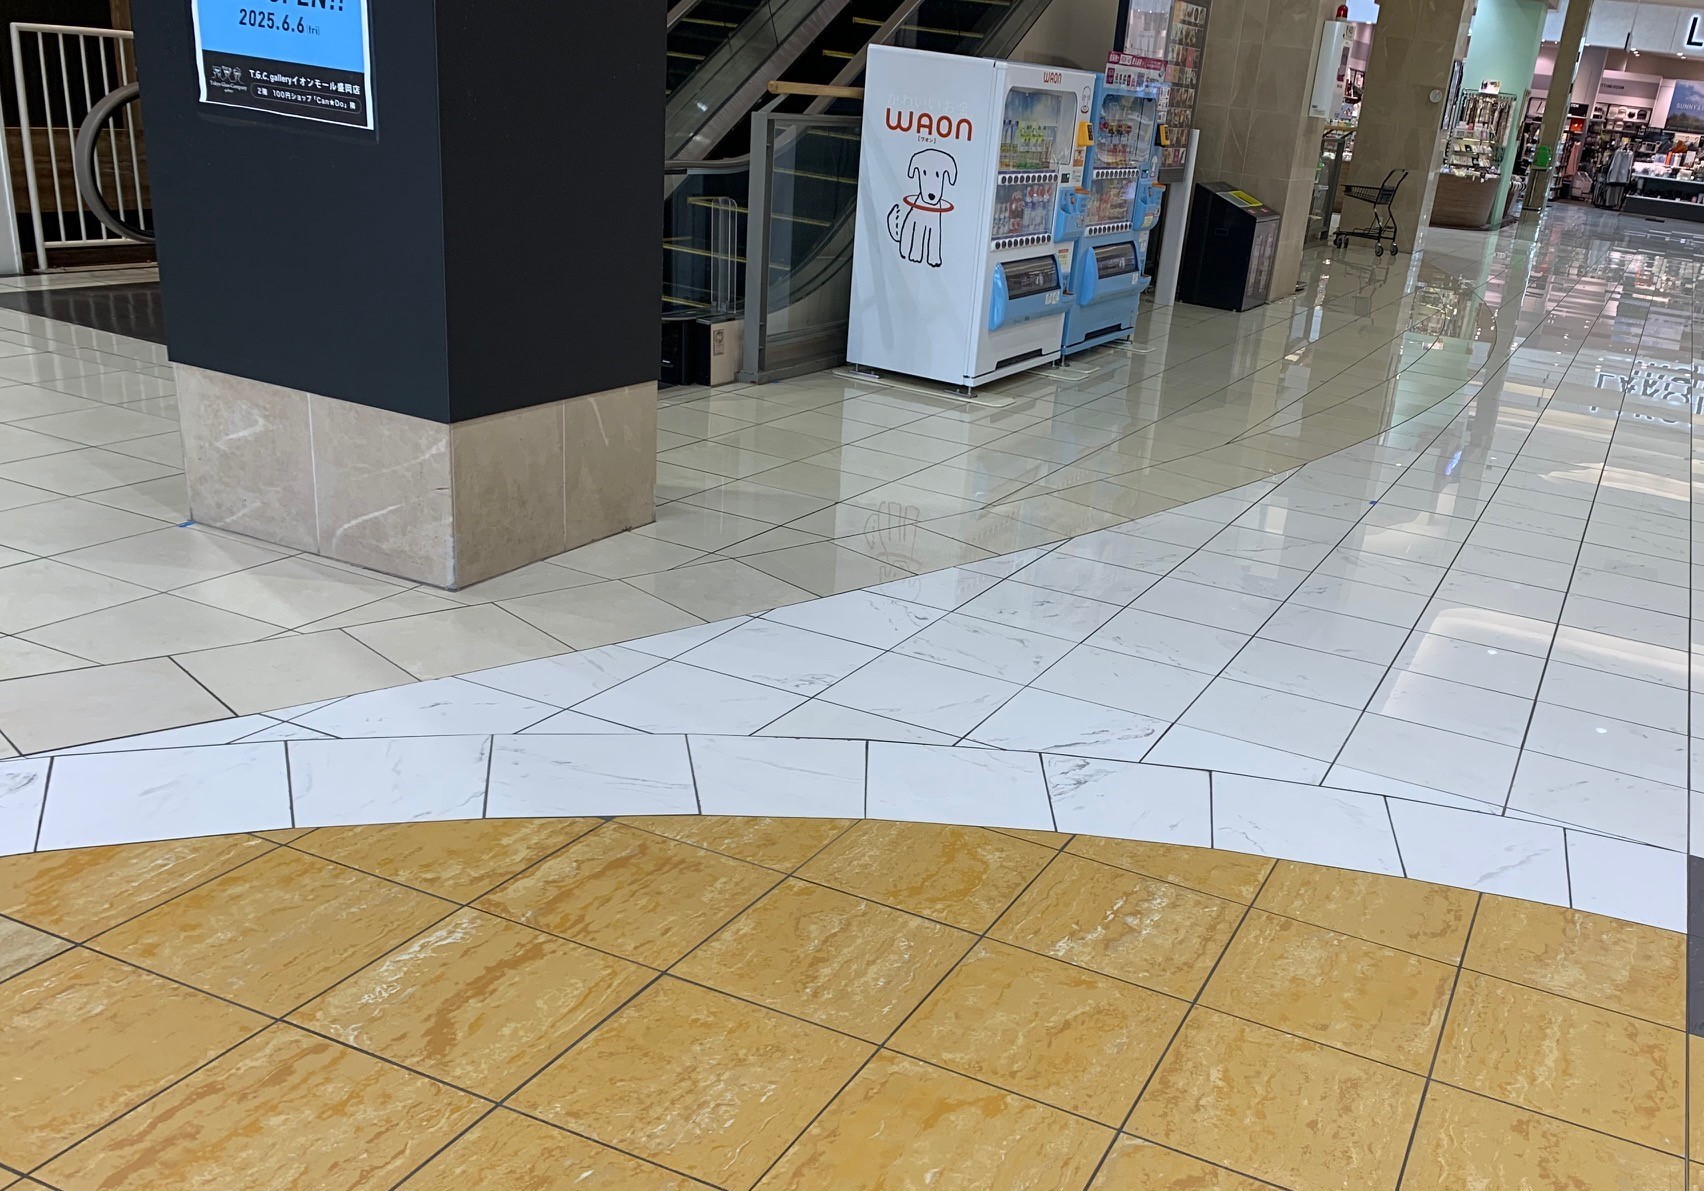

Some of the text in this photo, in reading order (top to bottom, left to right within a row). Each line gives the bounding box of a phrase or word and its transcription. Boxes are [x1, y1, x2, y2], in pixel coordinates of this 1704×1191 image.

[239, 8, 304, 34] 2025.6.6
[1686, 16, 1704, 47] L
[1043, 71, 1062, 84] WAON
[885, 107, 973, 141] WAON
